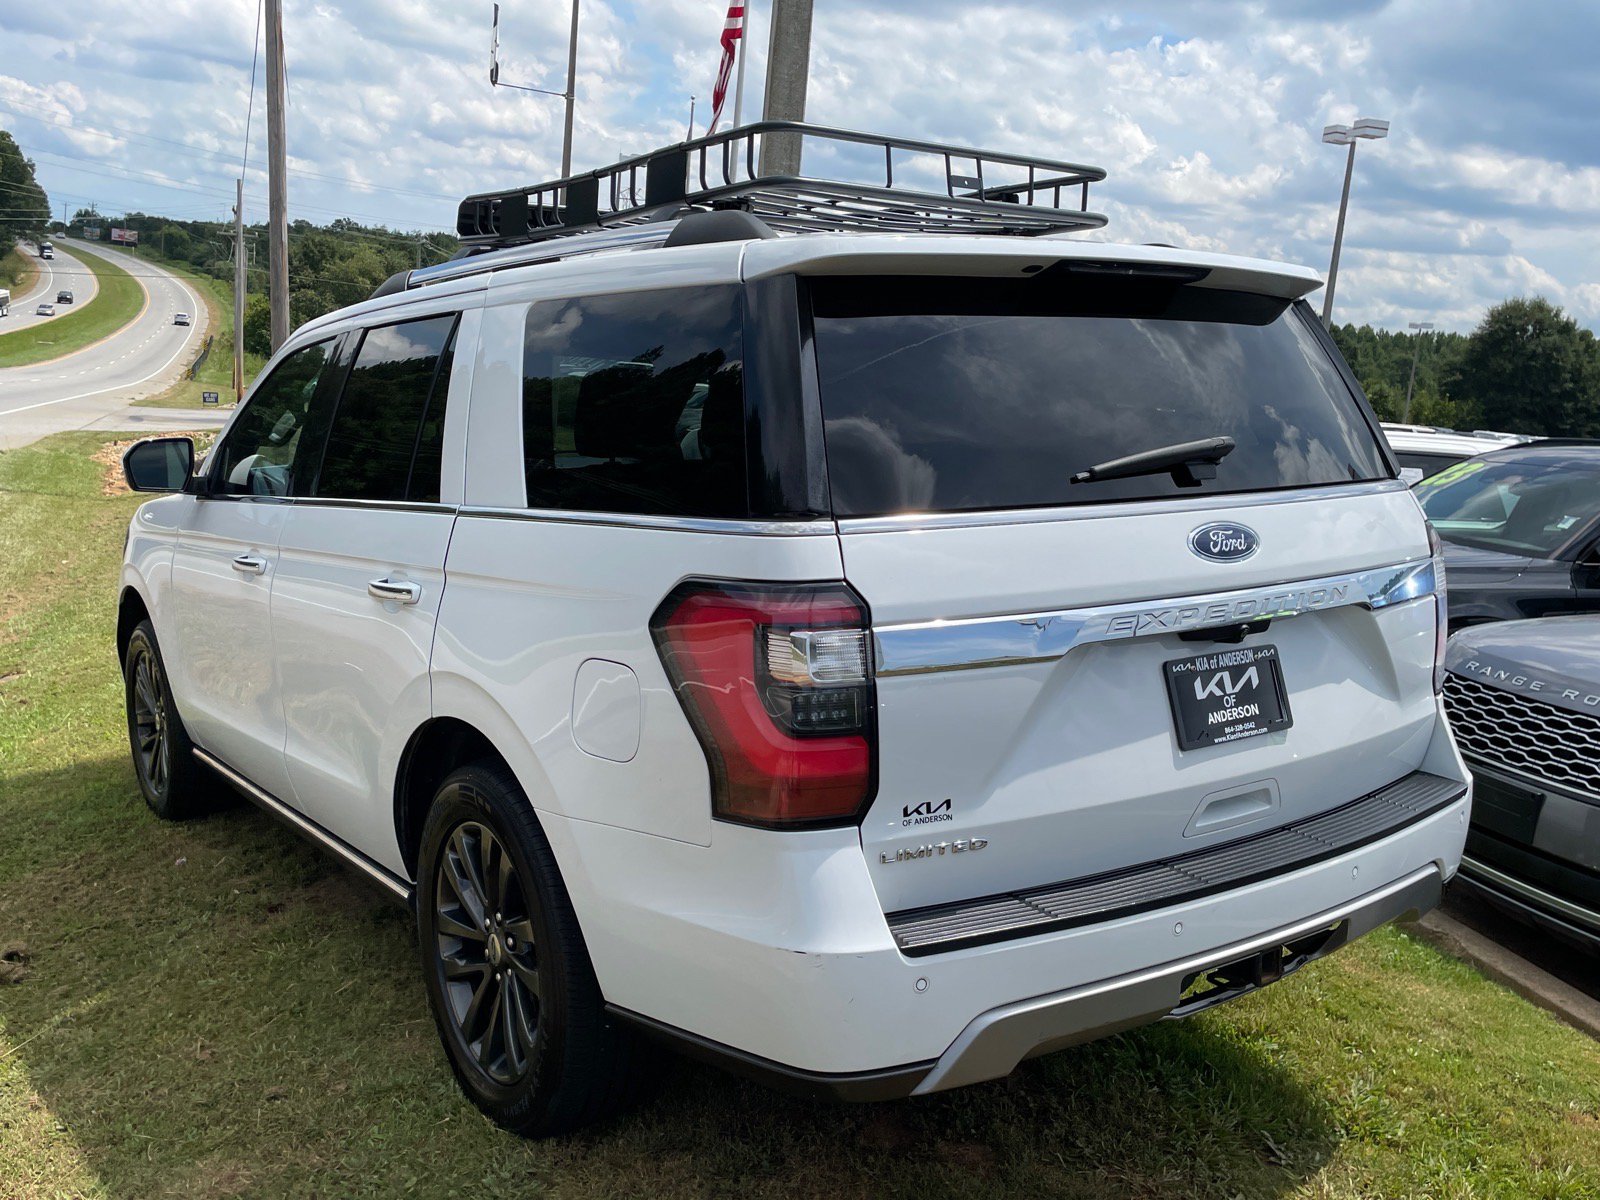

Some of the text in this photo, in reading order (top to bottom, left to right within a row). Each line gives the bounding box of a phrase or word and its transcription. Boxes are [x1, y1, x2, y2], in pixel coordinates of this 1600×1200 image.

[1209, 529, 1248, 554] Ford
[1105, 584, 1348, 637] EXPEDITION
[1195, 657, 1209, 671] KIA
[1210, 657, 1218, 669] of
[1218, 649, 1254, 669] ANDERSON
[1193, 665, 1260, 700] KIA
[1465, 660, 1545, 691] RANGE
[1223, 694, 1237, 707] OF
[1208, 703, 1260, 725] ANDERSON
[902, 798, 952, 818] KIA
[902, 813, 953, 827] OF ANDERSON
[879, 837, 988, 864] LIMITED
